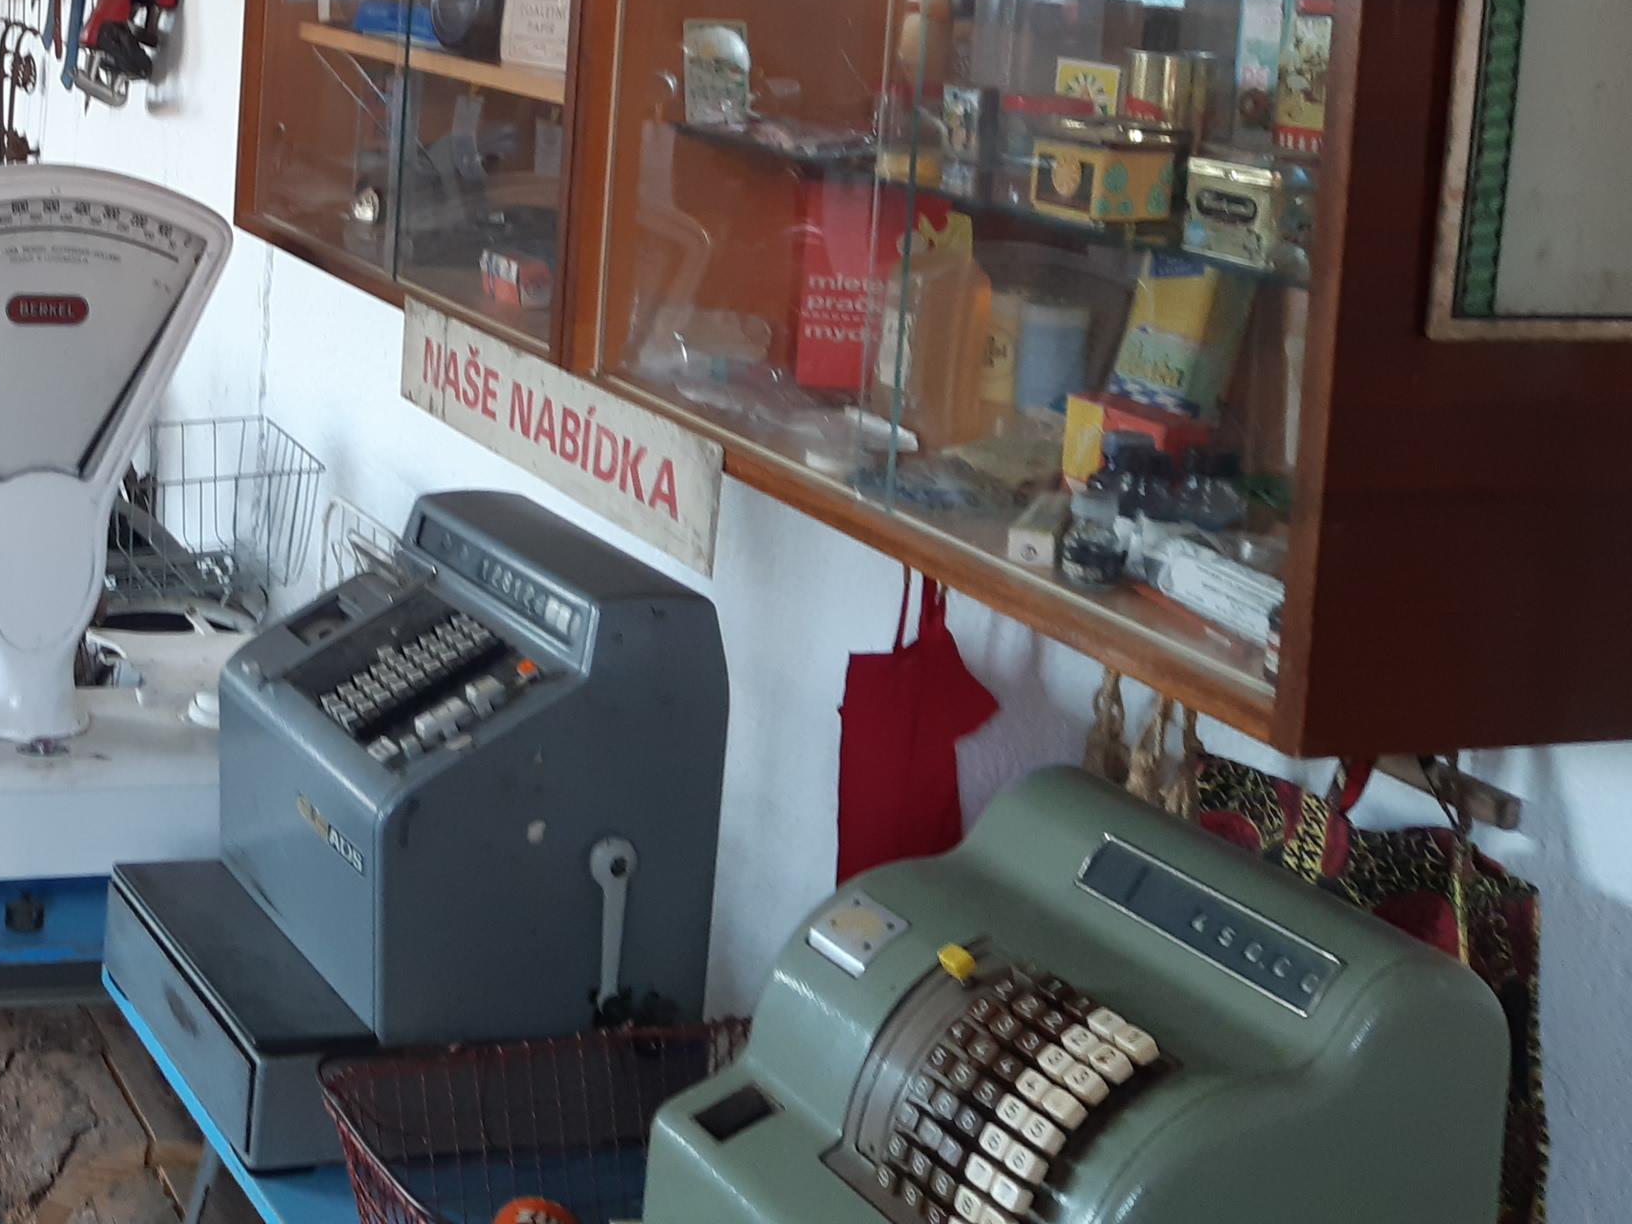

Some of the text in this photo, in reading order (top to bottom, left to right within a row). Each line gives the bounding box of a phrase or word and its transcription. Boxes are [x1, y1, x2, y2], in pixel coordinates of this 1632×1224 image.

[19, 299, 76, 320] BERKEL
[422, 337, 680, 522] NAŠE NABÍDKA
